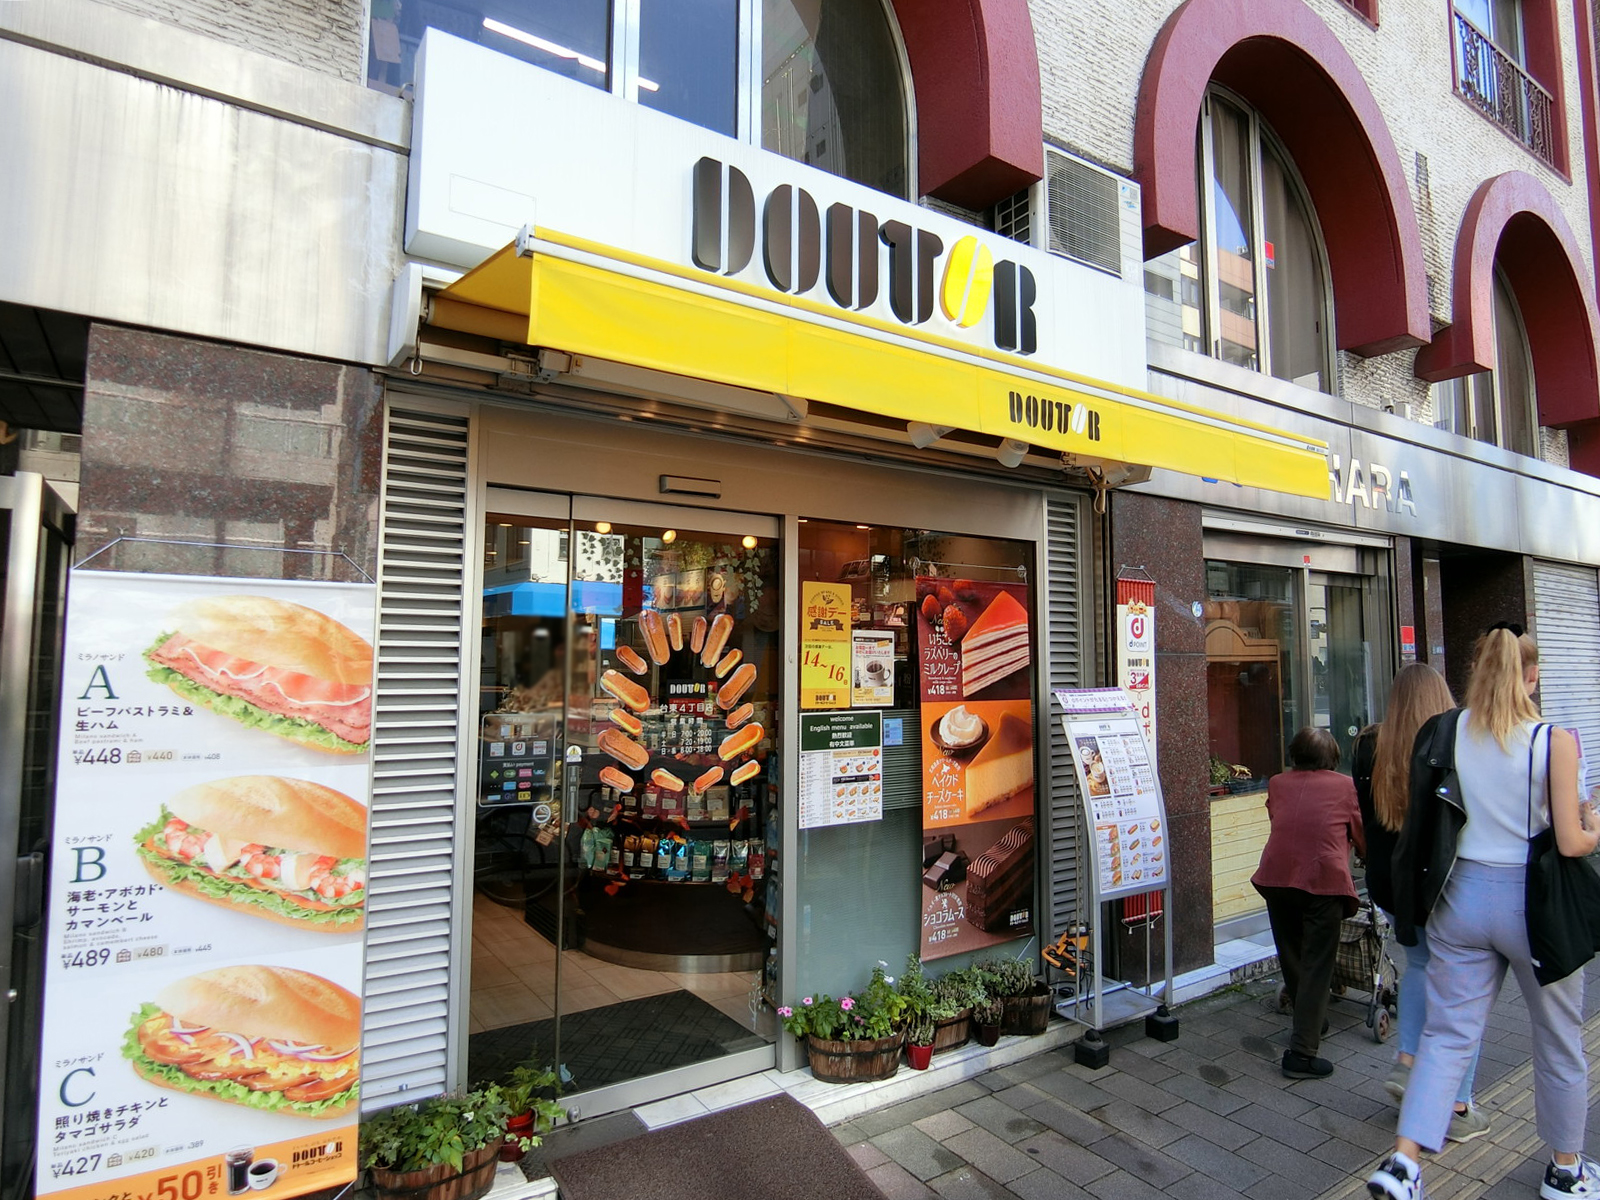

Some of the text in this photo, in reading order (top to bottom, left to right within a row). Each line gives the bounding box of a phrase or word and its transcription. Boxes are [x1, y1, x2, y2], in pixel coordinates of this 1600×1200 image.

[692, 156, 1036, 356] DOUTOR
[1009, 390, 1100, 442] DOUTOR
[807, 605, 847, 618] 感謝デー
[928, 633, 953, 646] いちごと
[77, 653, 125, 661] ミラノサンド
[924, 646, 958, 660] ラズベリーの
[923, 661, 962, 675] ミルクレープ
[1127, 658, 1149, 667] DOUTOR
[77, 664, 119, 699] A
[669, 683, 706, 694] DOUTOR
[927, 684, 946, 695] ¥418
[75, 720, 119, 732] 生ハム
[849, 722, 873, 730] available
[75, 748, 121, 765] ¥448
[148, 752, 172, 760] ¥440
[931, 774, 959, 788] ベイクド
[927, 788, 964, 804] チーズケーキ
[930, 809, 948, 820] ¥418
[64, 834, 113, 844] ミラノサンド
[69, 846, 107, 883] B
[66, 900, 138, 917] サーモンと
[924, 906, 965, 927] ショコラムース
[66, 912, 153, 931] カマンベール
[928, 929, 947, 943] ¥418
[63, 948, 110, 969] ¥489
[137, 947, 163, 958] ¥480
[55, 1053, 104, 1068] ミラノサンド
[59, 1067, 96, 1107] C
[55, 1097, 169, 1130] 照り焼きチキンと
[55, 1114, 142, 1144] タマゴサラダ
[293, 1141, 343, 1163] DOUTOR
[53, 1153, 102, 1179] ¥427
[128, 1148, 155, 1161] ¥420
[207, 1163, 222, 1195] 引き
